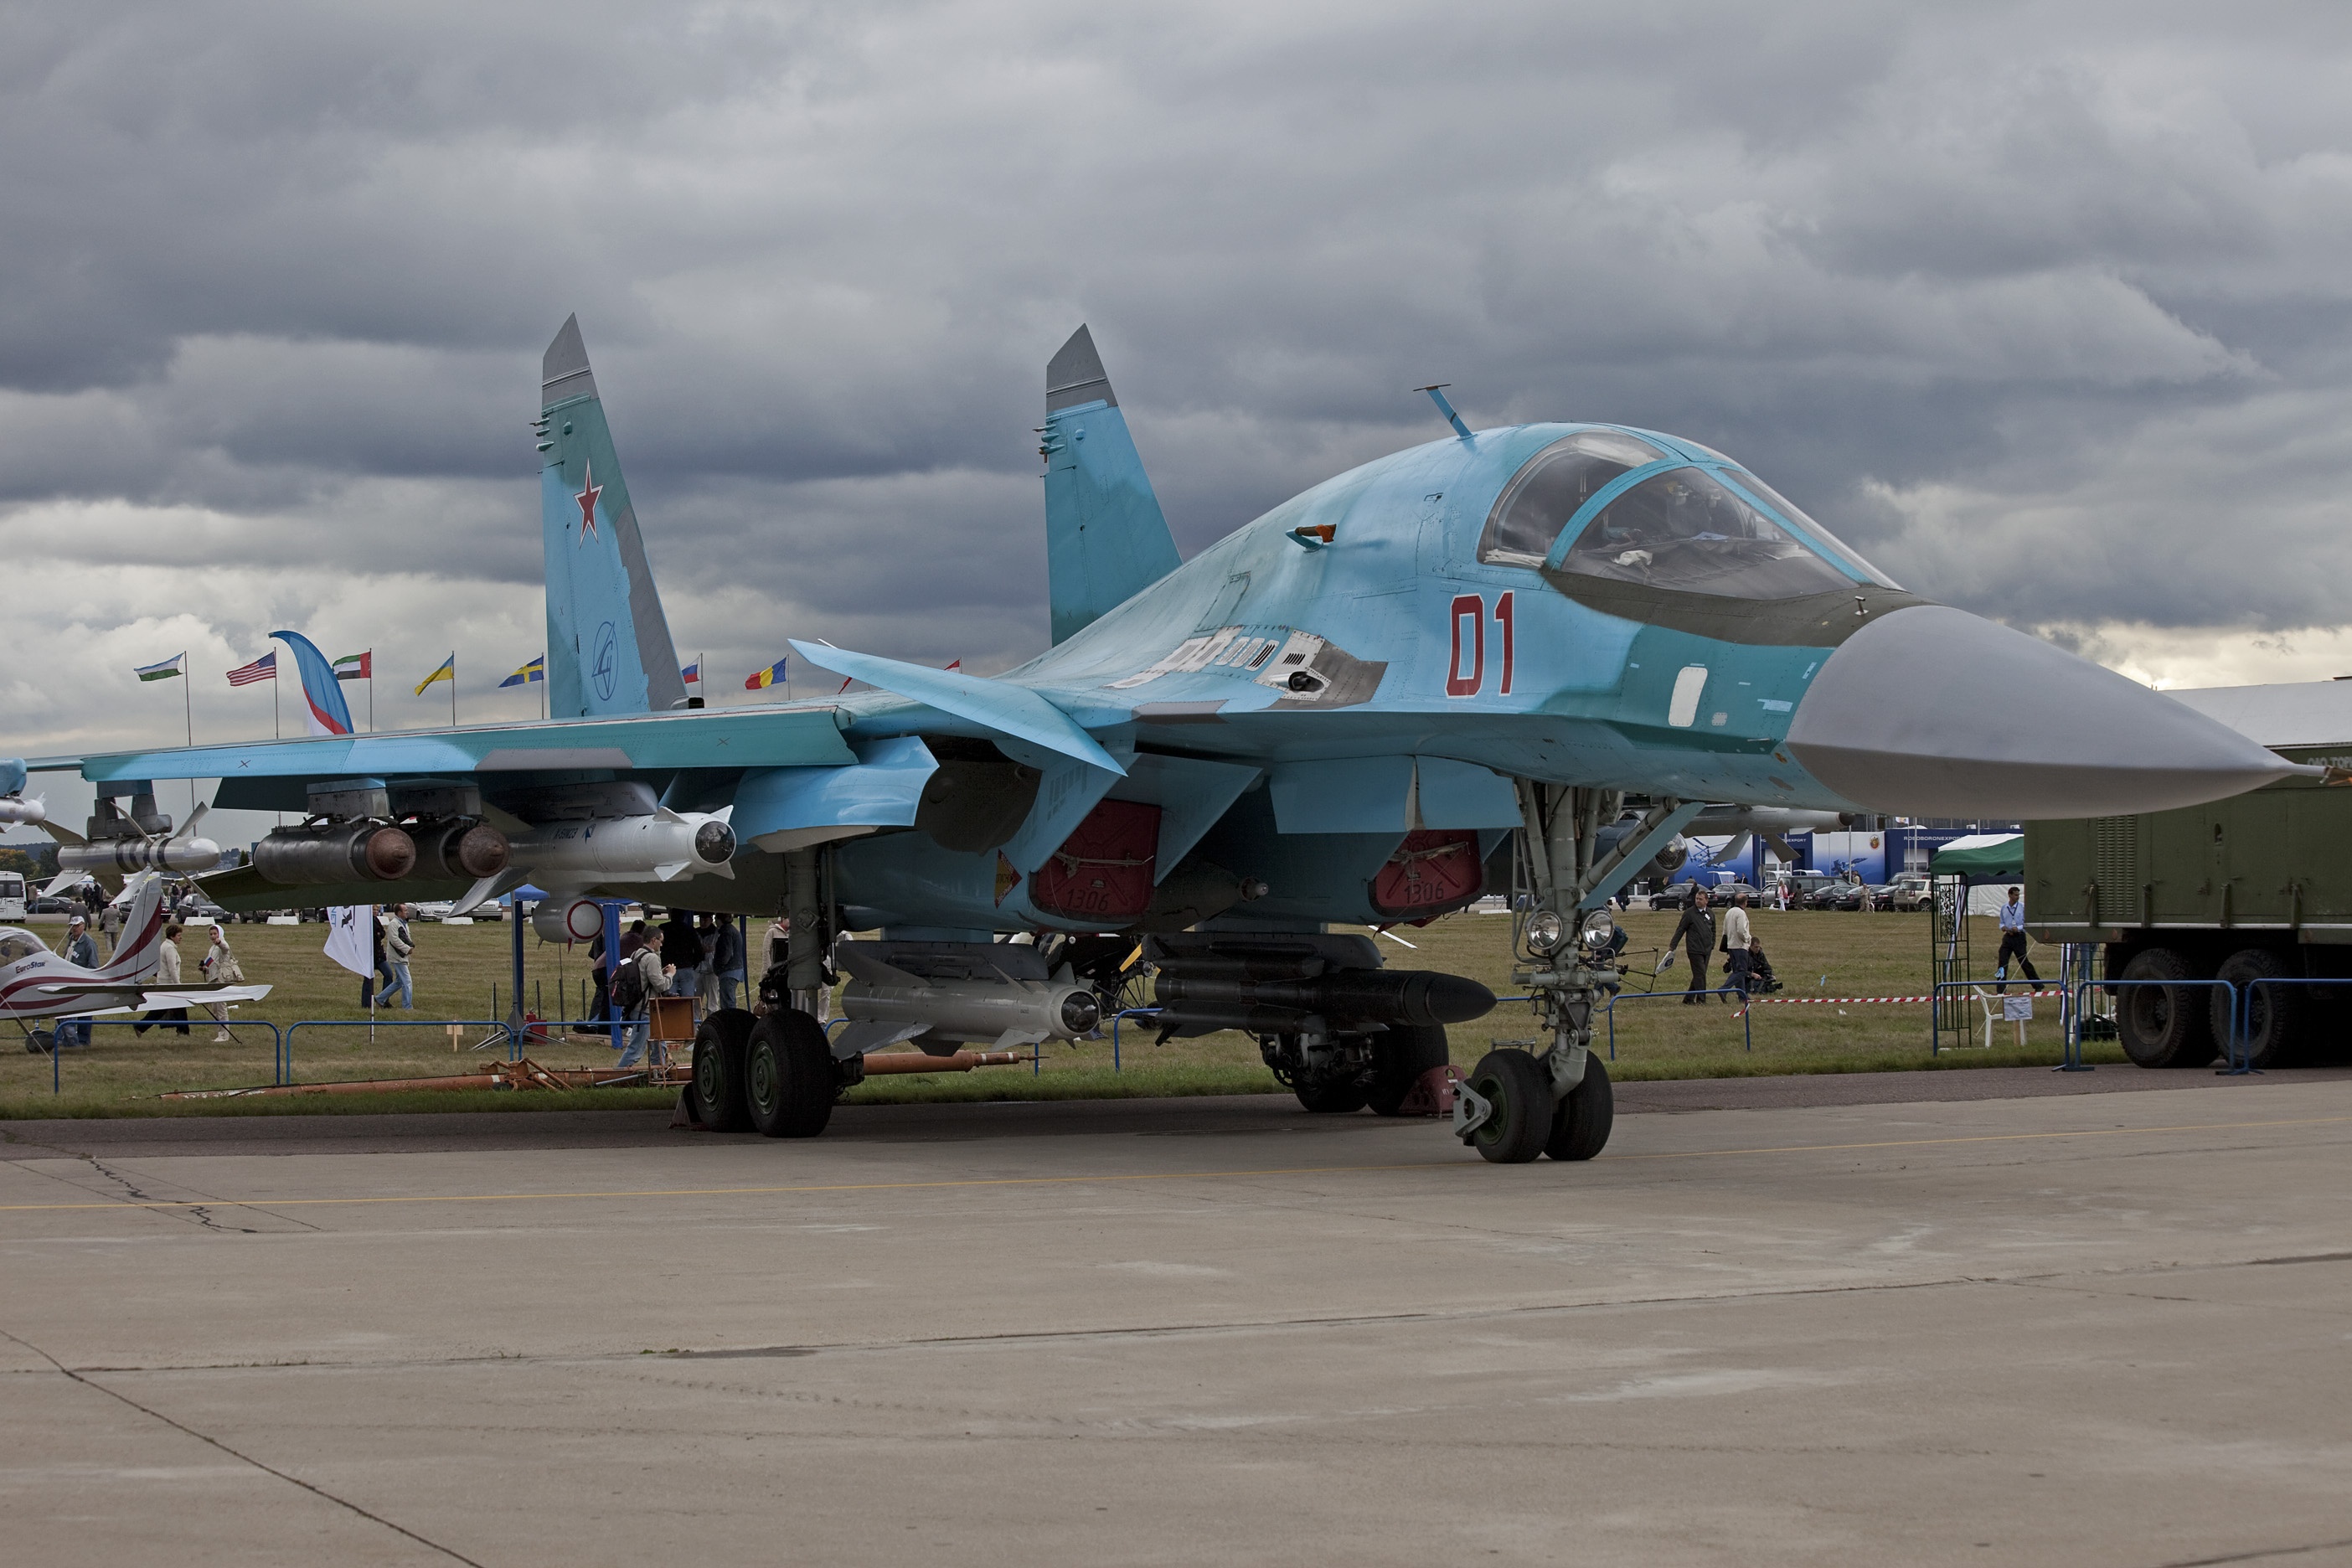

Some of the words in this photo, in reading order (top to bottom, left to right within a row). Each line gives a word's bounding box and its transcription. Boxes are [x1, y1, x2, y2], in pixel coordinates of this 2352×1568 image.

[1445, 590, 1514, 699] 01
[1067, 888, 1111, 912] 1306
[1404, 880, 1444, 905] 1306
